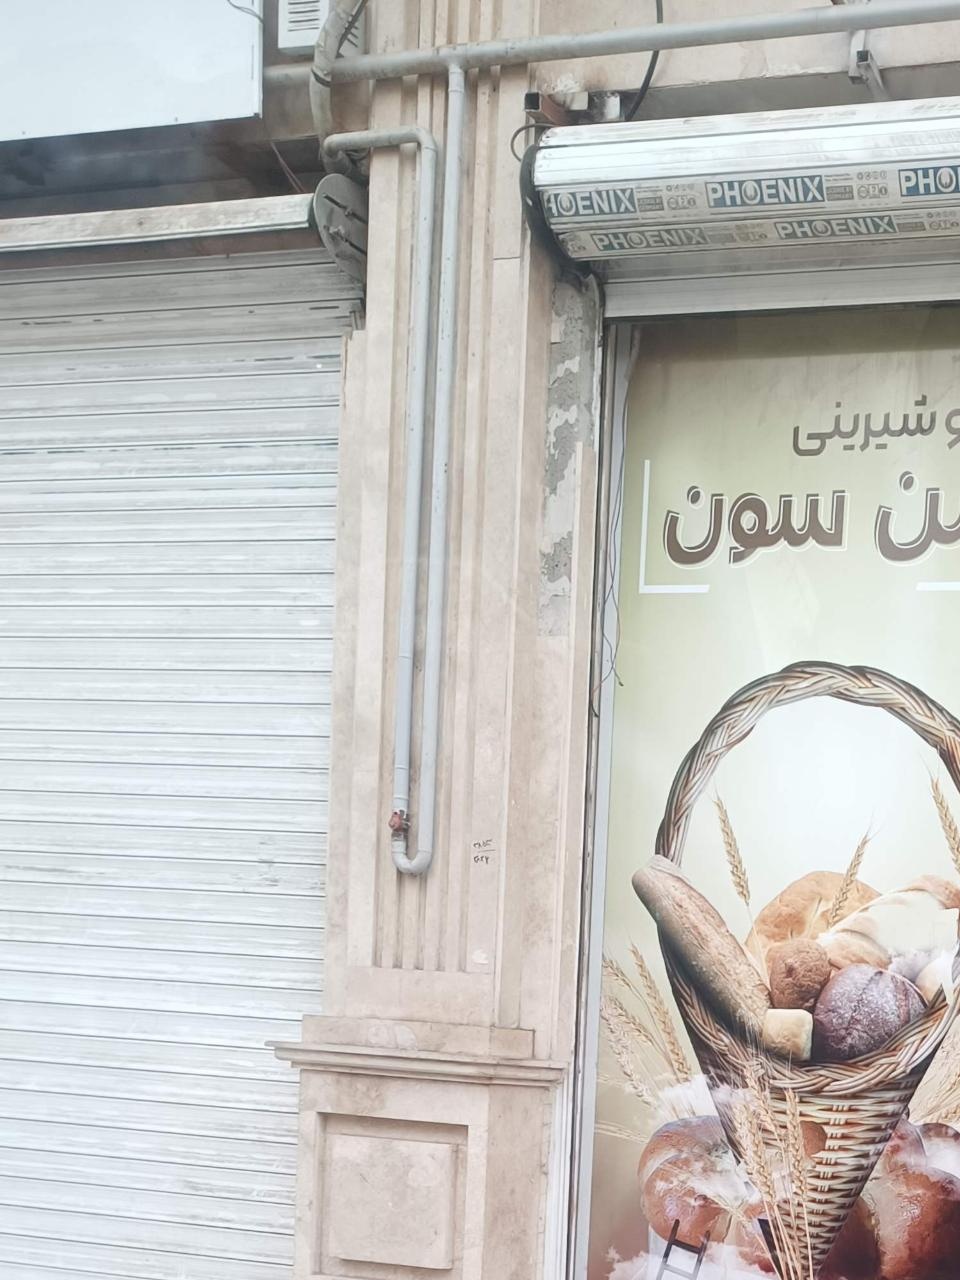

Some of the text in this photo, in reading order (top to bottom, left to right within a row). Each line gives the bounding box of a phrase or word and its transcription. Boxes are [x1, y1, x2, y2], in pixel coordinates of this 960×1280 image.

[545, 188, 636, 217] HOENIX
[708, 176, 824, 207] PHOENIX
[593, 228, 708, 251] PHOENIX
[776, 216, 898, 240] PHOENIX
[792, 394, 937, 456] شیرینی
[662, 484, 850, 569] سون
